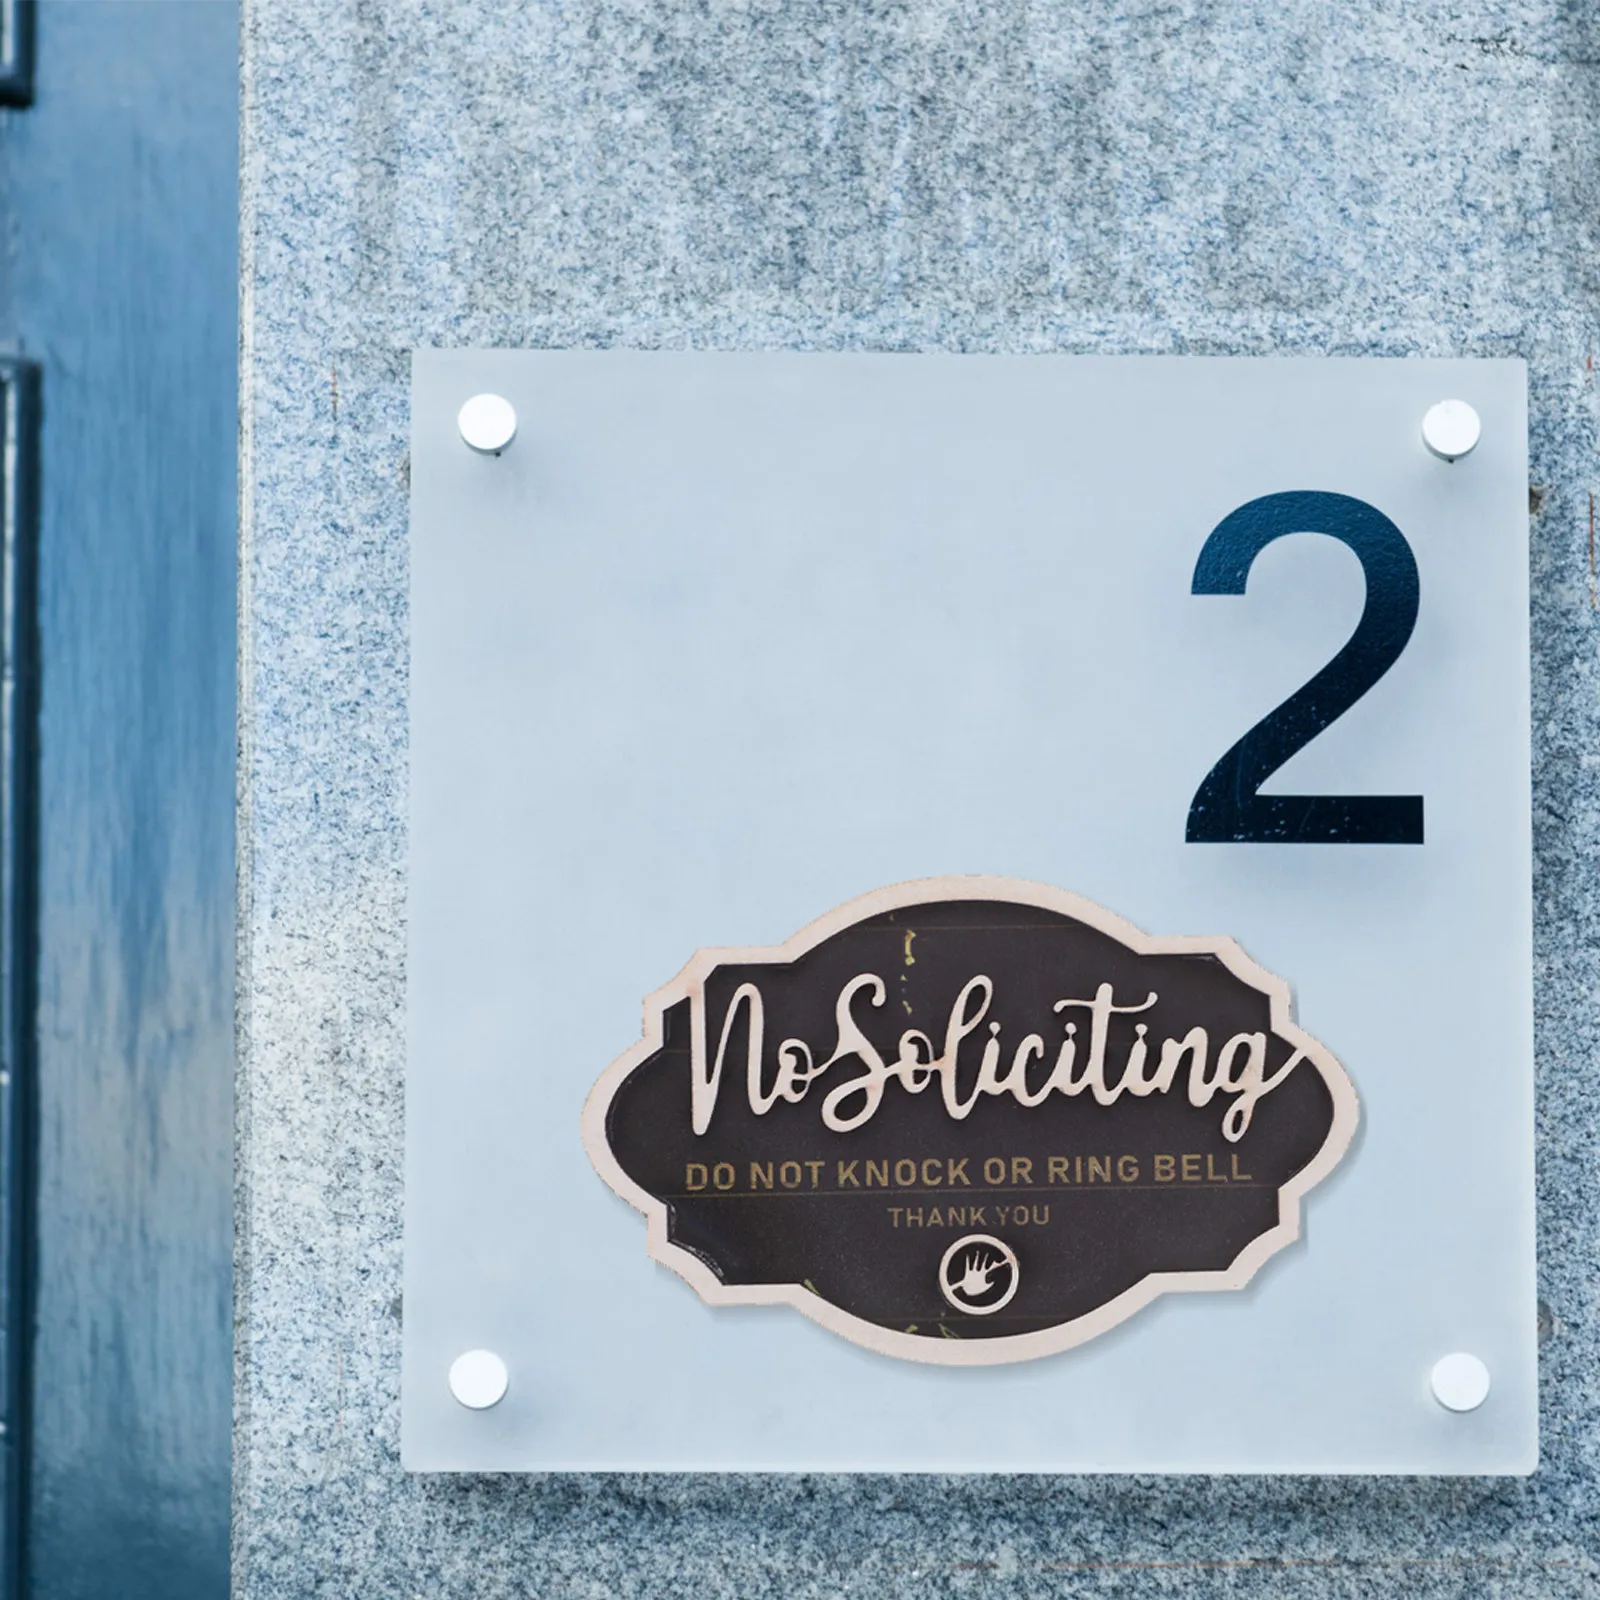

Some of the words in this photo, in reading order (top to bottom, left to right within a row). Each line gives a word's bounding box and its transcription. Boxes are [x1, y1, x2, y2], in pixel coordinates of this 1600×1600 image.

[1186, 490, 1424, 843] 2
[821, 973, 1303, 1143] Soliciting
[686, 1162, 736, 1191] DO
[750, 1160, 826, 1190] NOT
[838, 1158, 971, 1187] KNOCK
[983, 1156, 1034, 1186] OR
[1047, 1154, 1140, 1184] RING
[1153, 1153, 1253, 1183] BELL
[888, 1207, 988, 1228] THANK
[996, 1205, 1051, 1227] YOU
